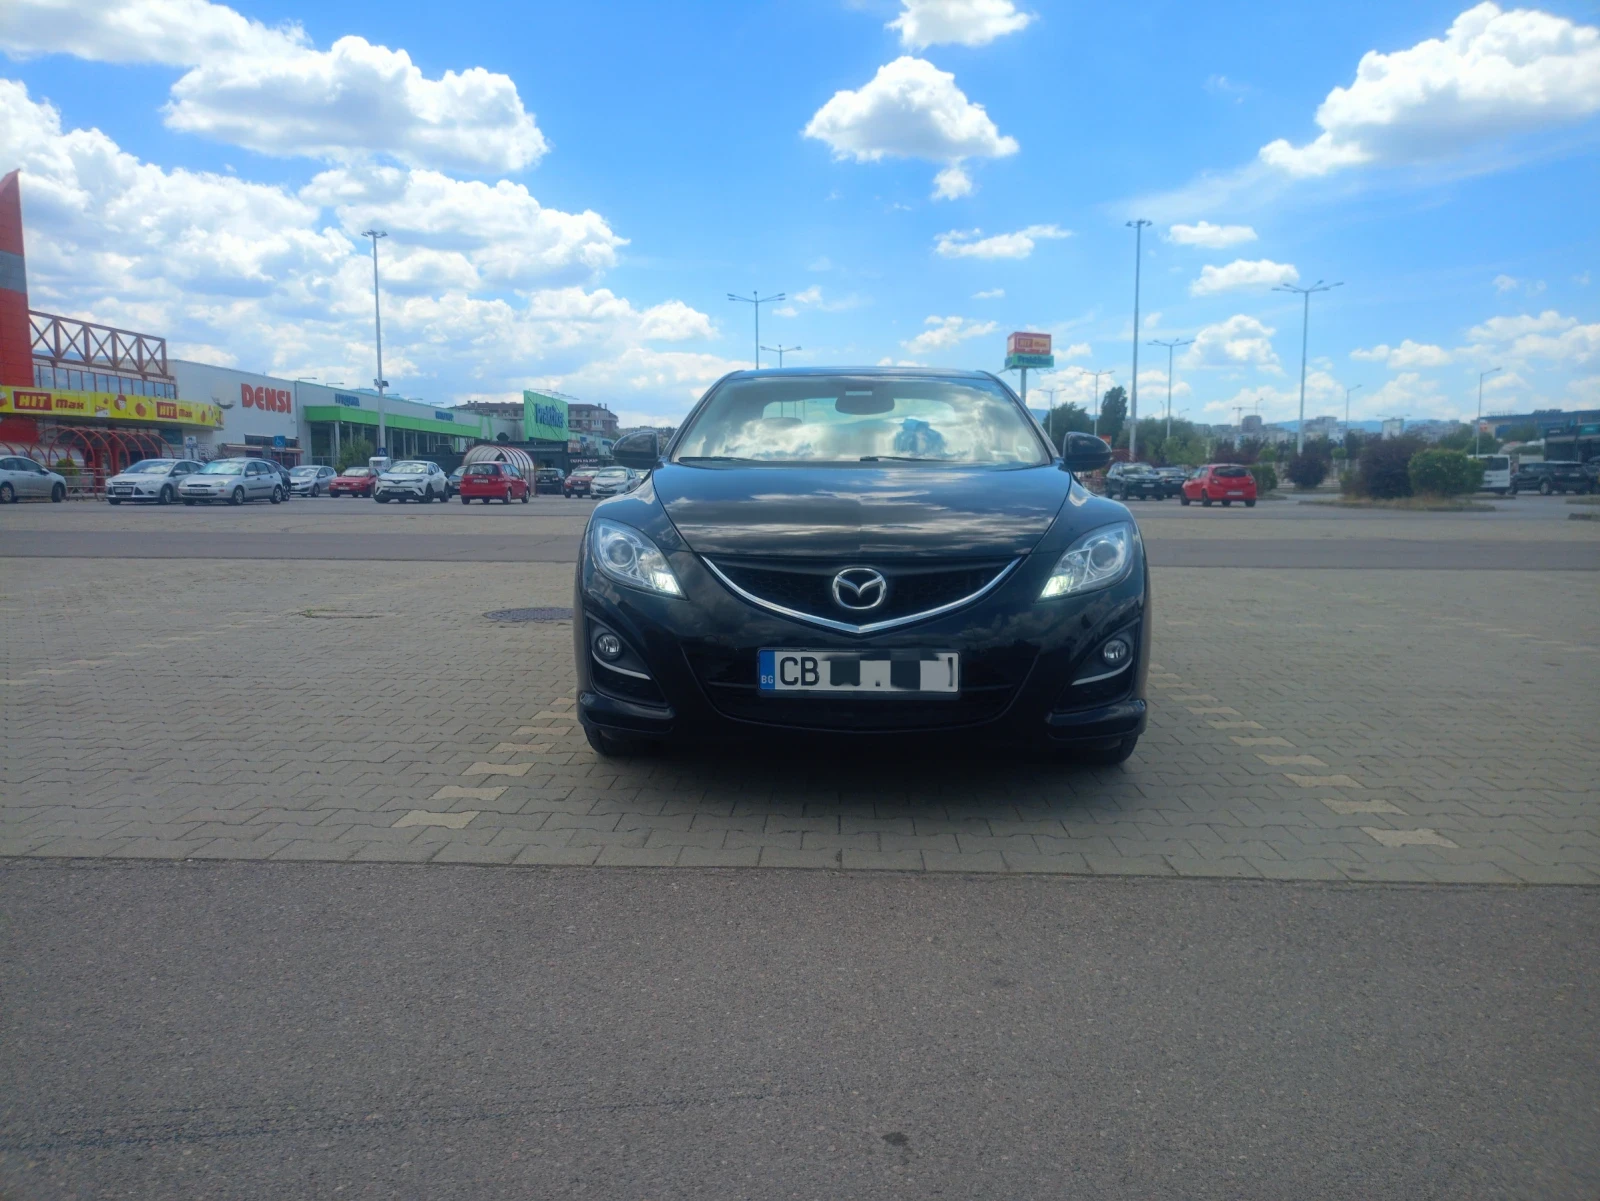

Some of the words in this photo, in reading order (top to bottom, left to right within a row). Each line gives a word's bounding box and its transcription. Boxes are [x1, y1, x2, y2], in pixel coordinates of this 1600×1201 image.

[18, 394, 48, 408] HIT
[55, 398, 85, 410] Max
[241, 383, 292, 414] DENSI
[160, 404, 175, 417] HIT
[761, 675, 774, 684] BG
[779, 656, 820, 687] CB
